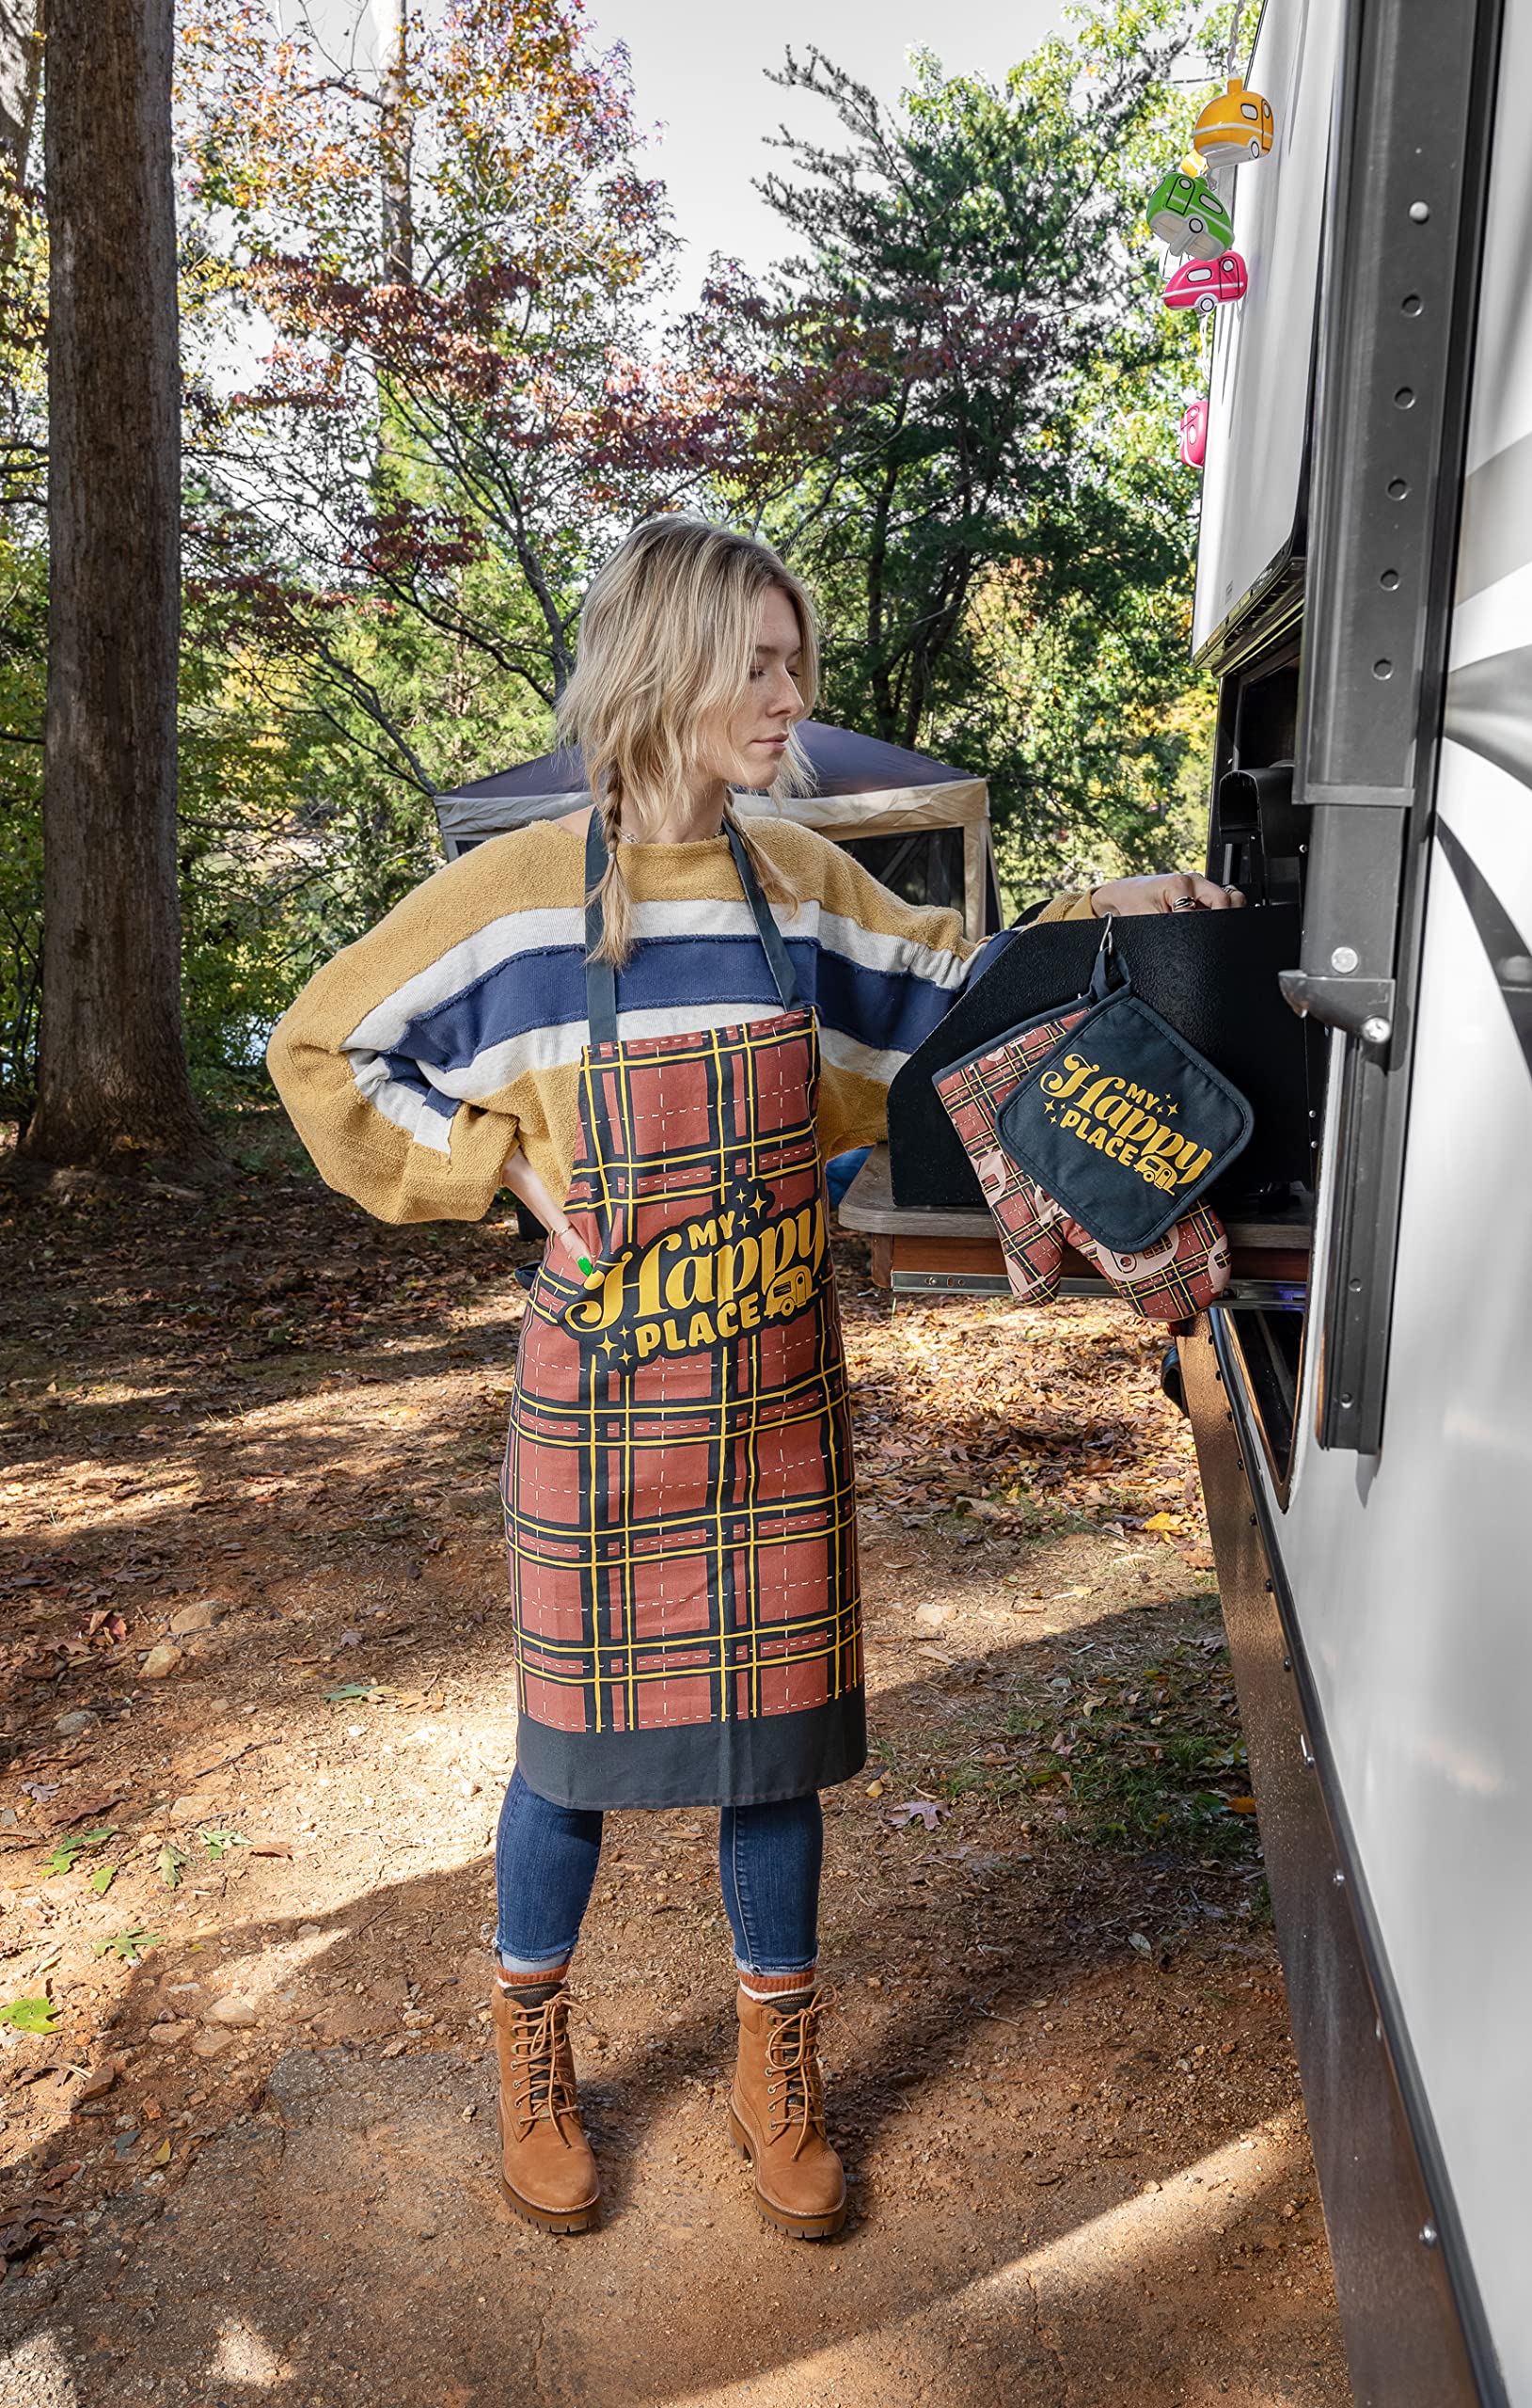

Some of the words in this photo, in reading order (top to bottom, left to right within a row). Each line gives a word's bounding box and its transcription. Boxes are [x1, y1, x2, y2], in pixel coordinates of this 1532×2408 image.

[1040, 1054, 1213, 1184] Happy
[1125, 1083, 1160, 1108] MY
[1060, 1109, 1139, 1167] PLACE
[687, 1211, 735, 1251] MY
[565, 1198, 824, 1332] Happy
[635, 1291, 761, 1357] PLACE
